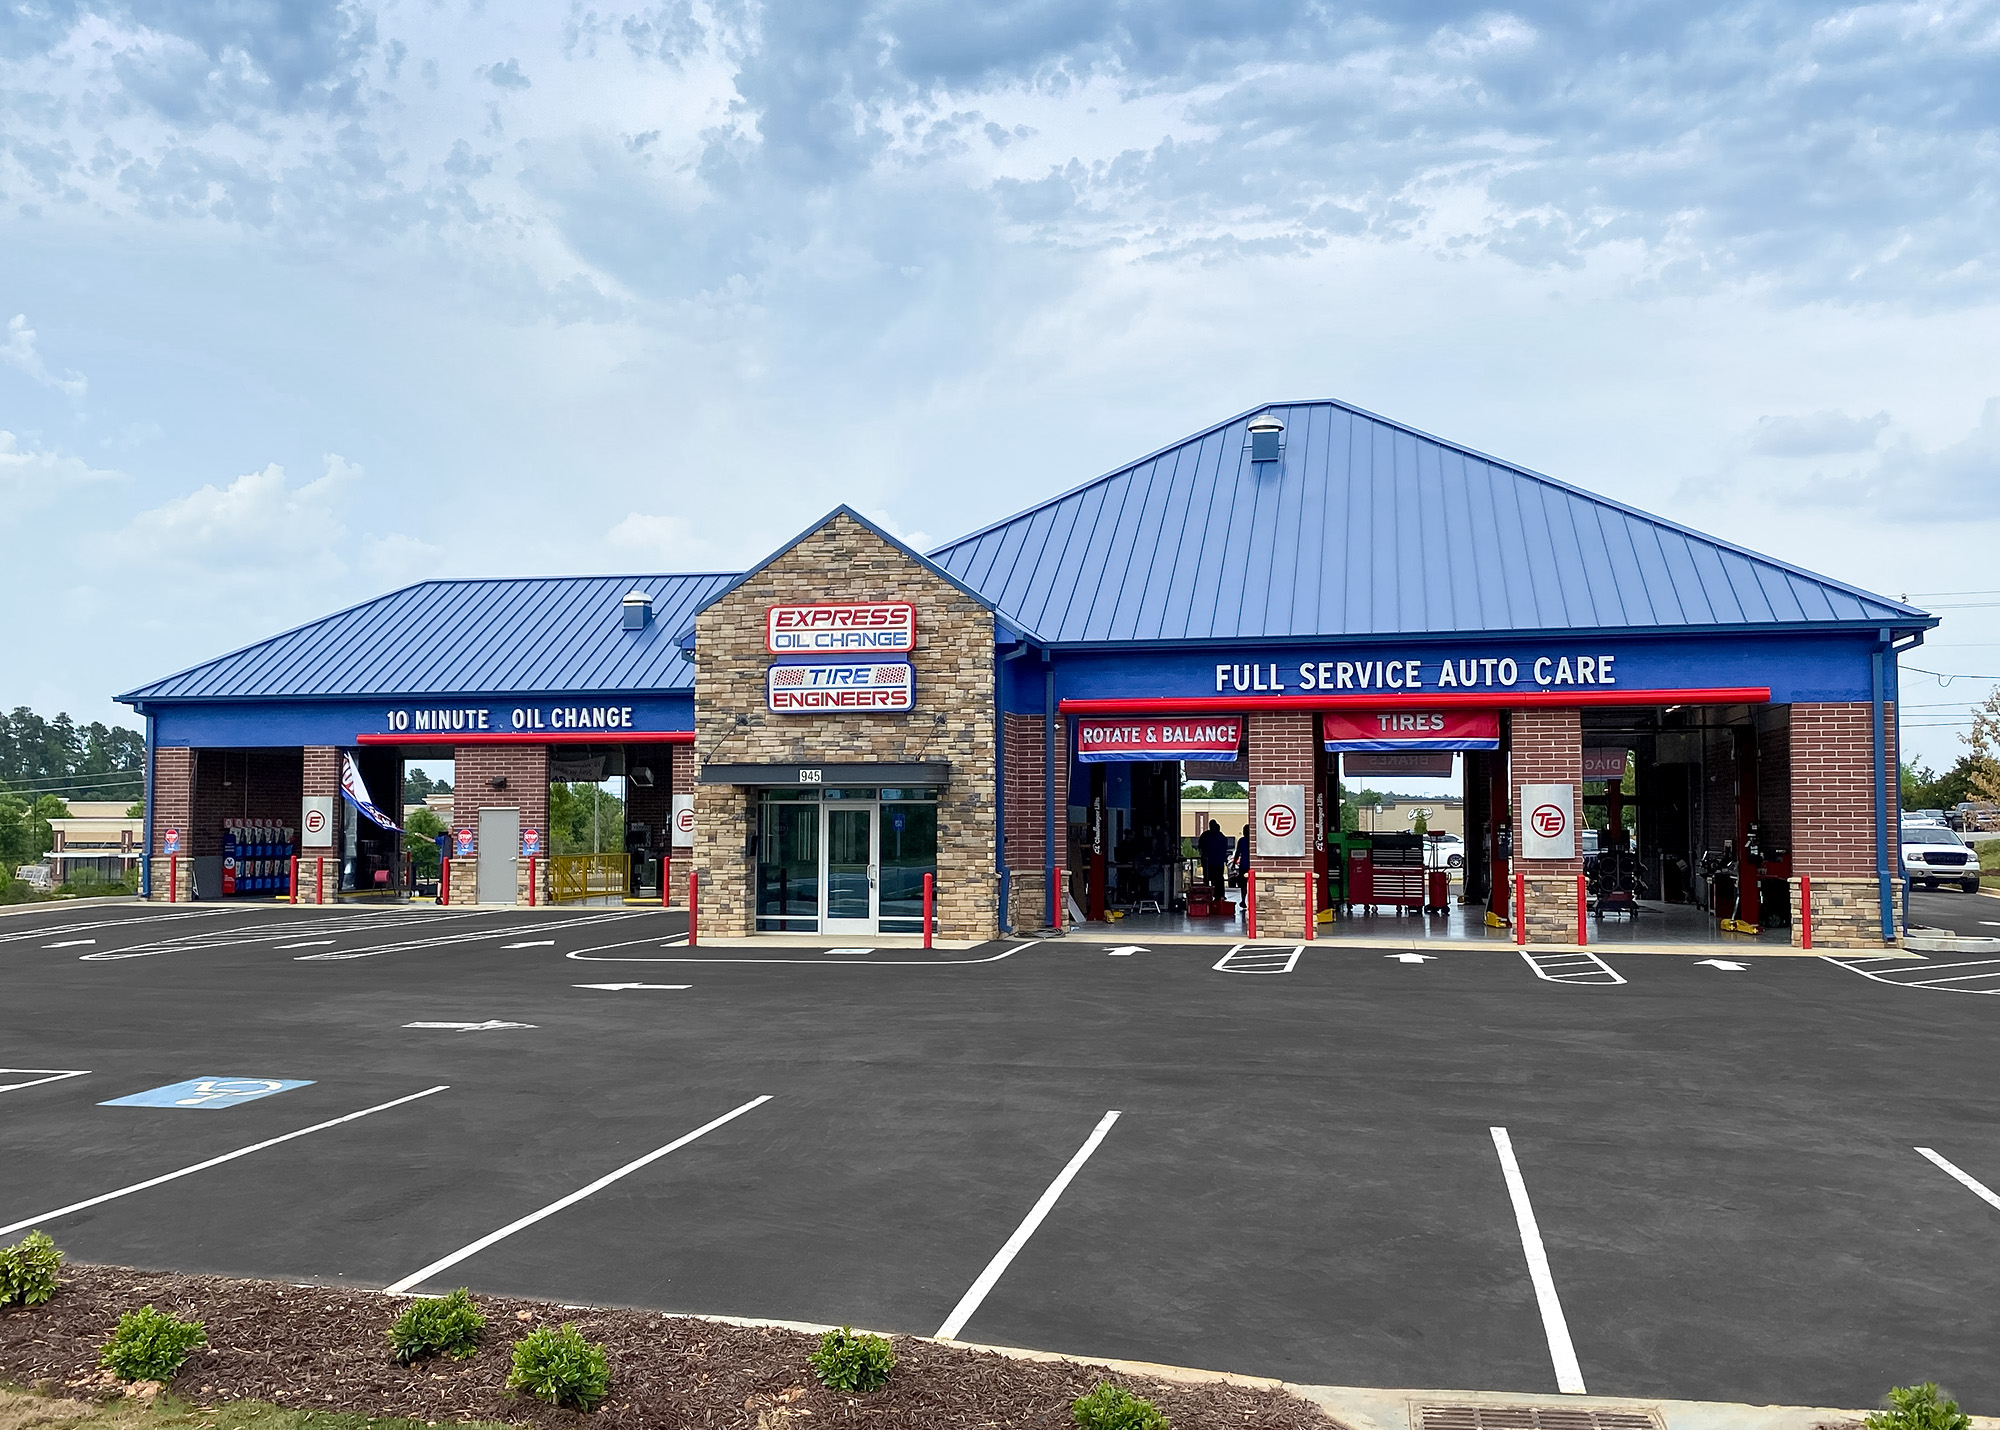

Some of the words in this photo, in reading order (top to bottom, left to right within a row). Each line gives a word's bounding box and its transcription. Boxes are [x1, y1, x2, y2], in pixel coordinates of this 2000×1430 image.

[775, 608, 909, 627] EXPRESS
[775, 634, 810, 648] OIL
[815, 632, 908, 647] CHANGE
[808, 667, 872, 685] TIRE
[1216, 664, 1285, 691] FULL
[1299, 660, 1422, 690] SERVICE
[1437, 657, 1518, 687] AUTO
[1533, 655, 1616, 685] CARE
[773, 690, 908, 708] ENGINEERS
[387, 710, 409, 731] 10
[415, 709, 490, 730] MINUTE
[511, 708, 546, 729] OIL
[551, 706, 633, 728] CHANGE
[1377, 713, 1445, 731] TIRES
[1083, 726, 1141, 743] ROTATE
[1146, 726, 1157, 743] &
[1162, 725, 1237, 743] BALANCE
[801, 770, 820, 782] 945
[309, 816, 321, 827] E
[681, 815, 694, 827] E
[1093, 810, 1102, 844] Challenger
[1268, 812, 1293, 830] TE
[1316, 807, 1325, 841] Challenger
[1536, 812, 1562, 831] TE
